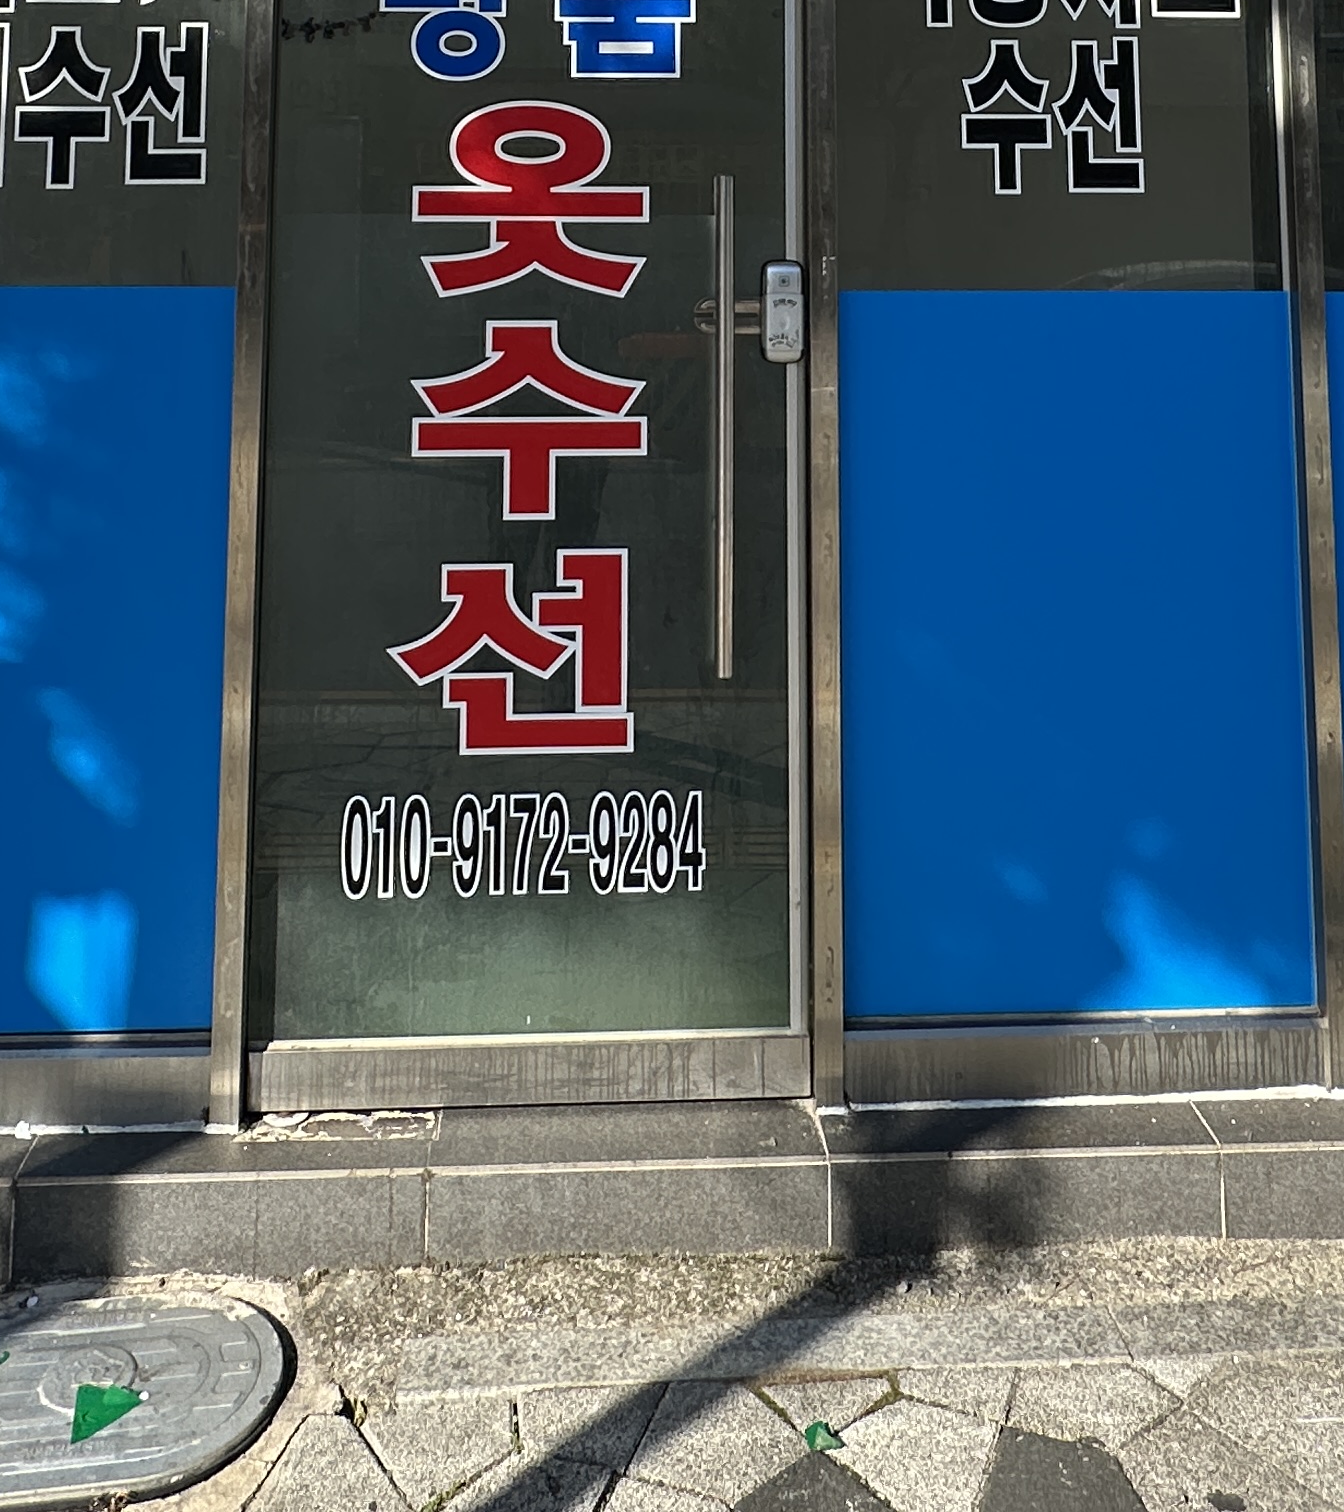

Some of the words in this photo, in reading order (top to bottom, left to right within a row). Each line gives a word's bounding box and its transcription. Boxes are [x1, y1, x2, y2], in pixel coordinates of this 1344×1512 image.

[960, 36, 1146, 195] 수선
[386, 100, 650, 756] 옷수선
[340, 789, 707, 900] 010-9172-9284
